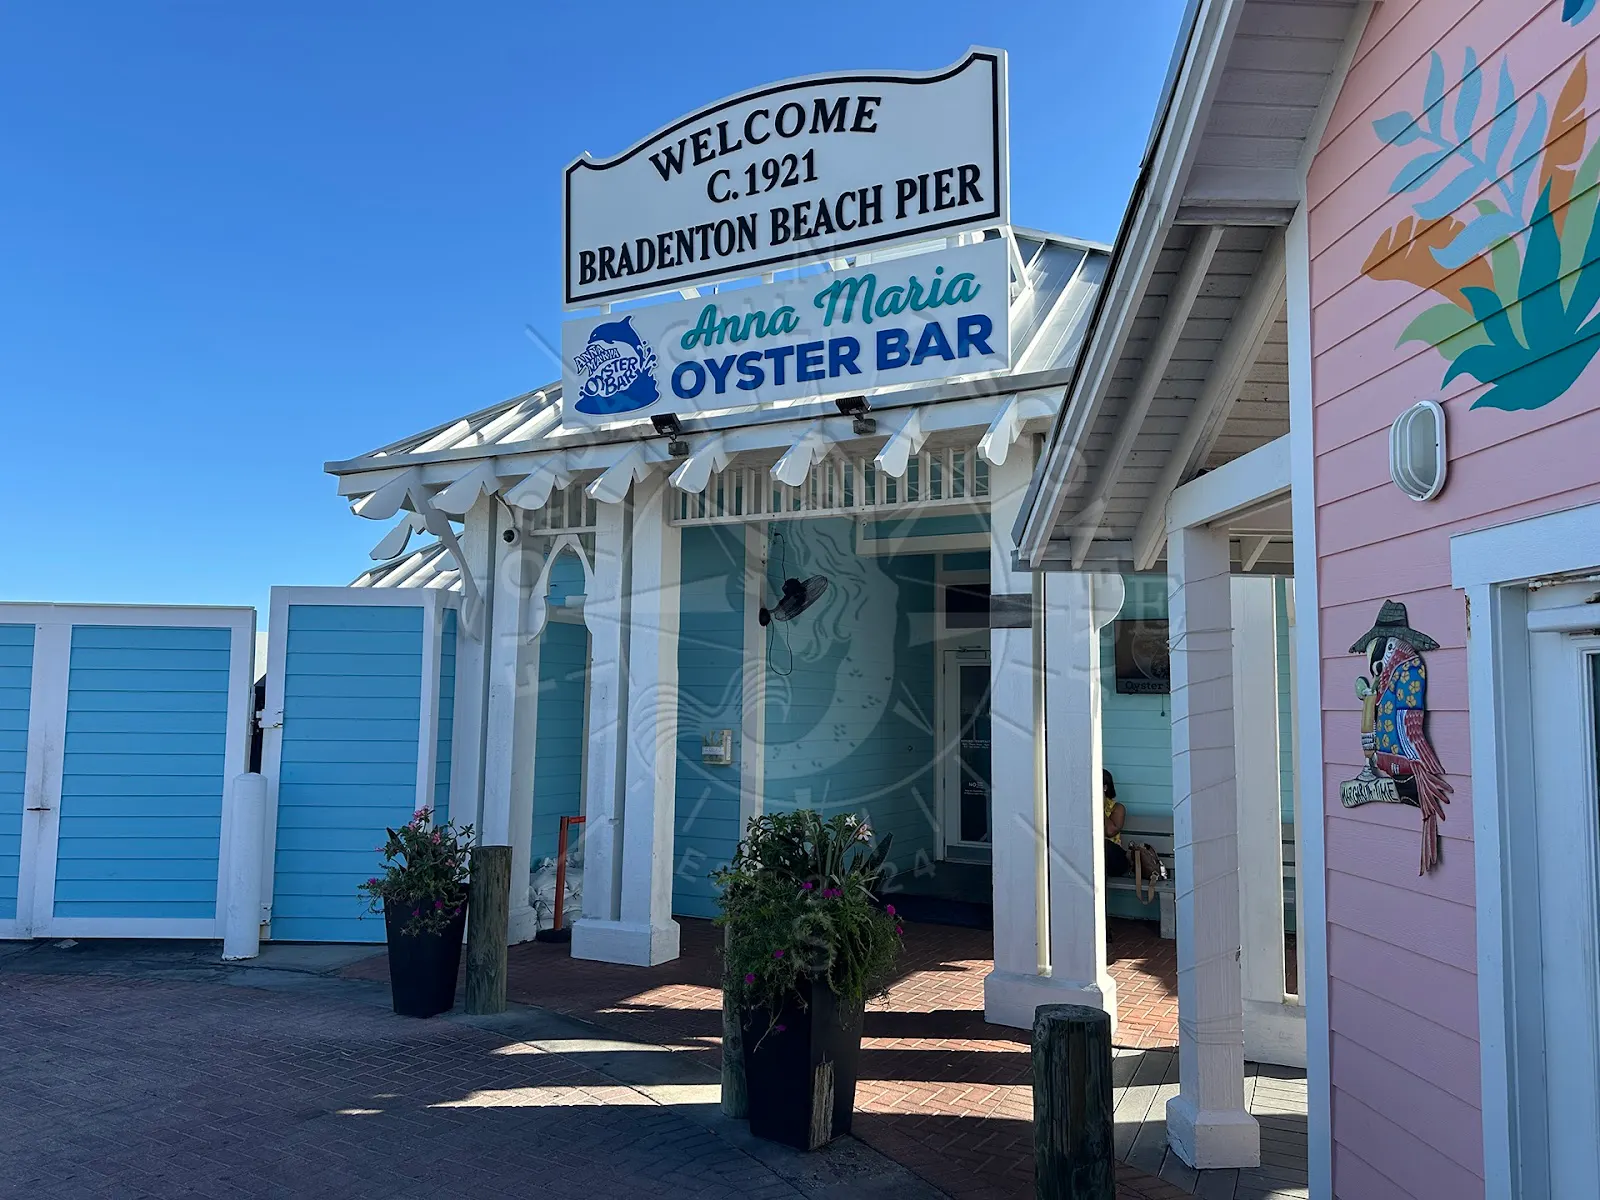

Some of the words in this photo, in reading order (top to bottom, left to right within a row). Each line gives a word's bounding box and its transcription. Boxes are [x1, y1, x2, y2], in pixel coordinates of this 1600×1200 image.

[648, 96, 882, 182] WELCOME
[706, 148, 819, 203] C.1921
[578, 213, 757, 286] BRADENTON
[769, 183, 882, 246] BEACH
[895, 163, 984, 219] PIER
[680, 303, 800, 350] Anna
[813, 265, 982, 328] Maria
[573, 344, 606, 374] ANNA
[584, 357, 638, 395] OYSTER
[588, 351, 621, 377] MARIA
[671, 336, 862, 399] OYSTER
[876, 314, 995, 369] BAR
[603, 369, 637, 396] BAR
[1125, 681, 1164, 692] Oyster
